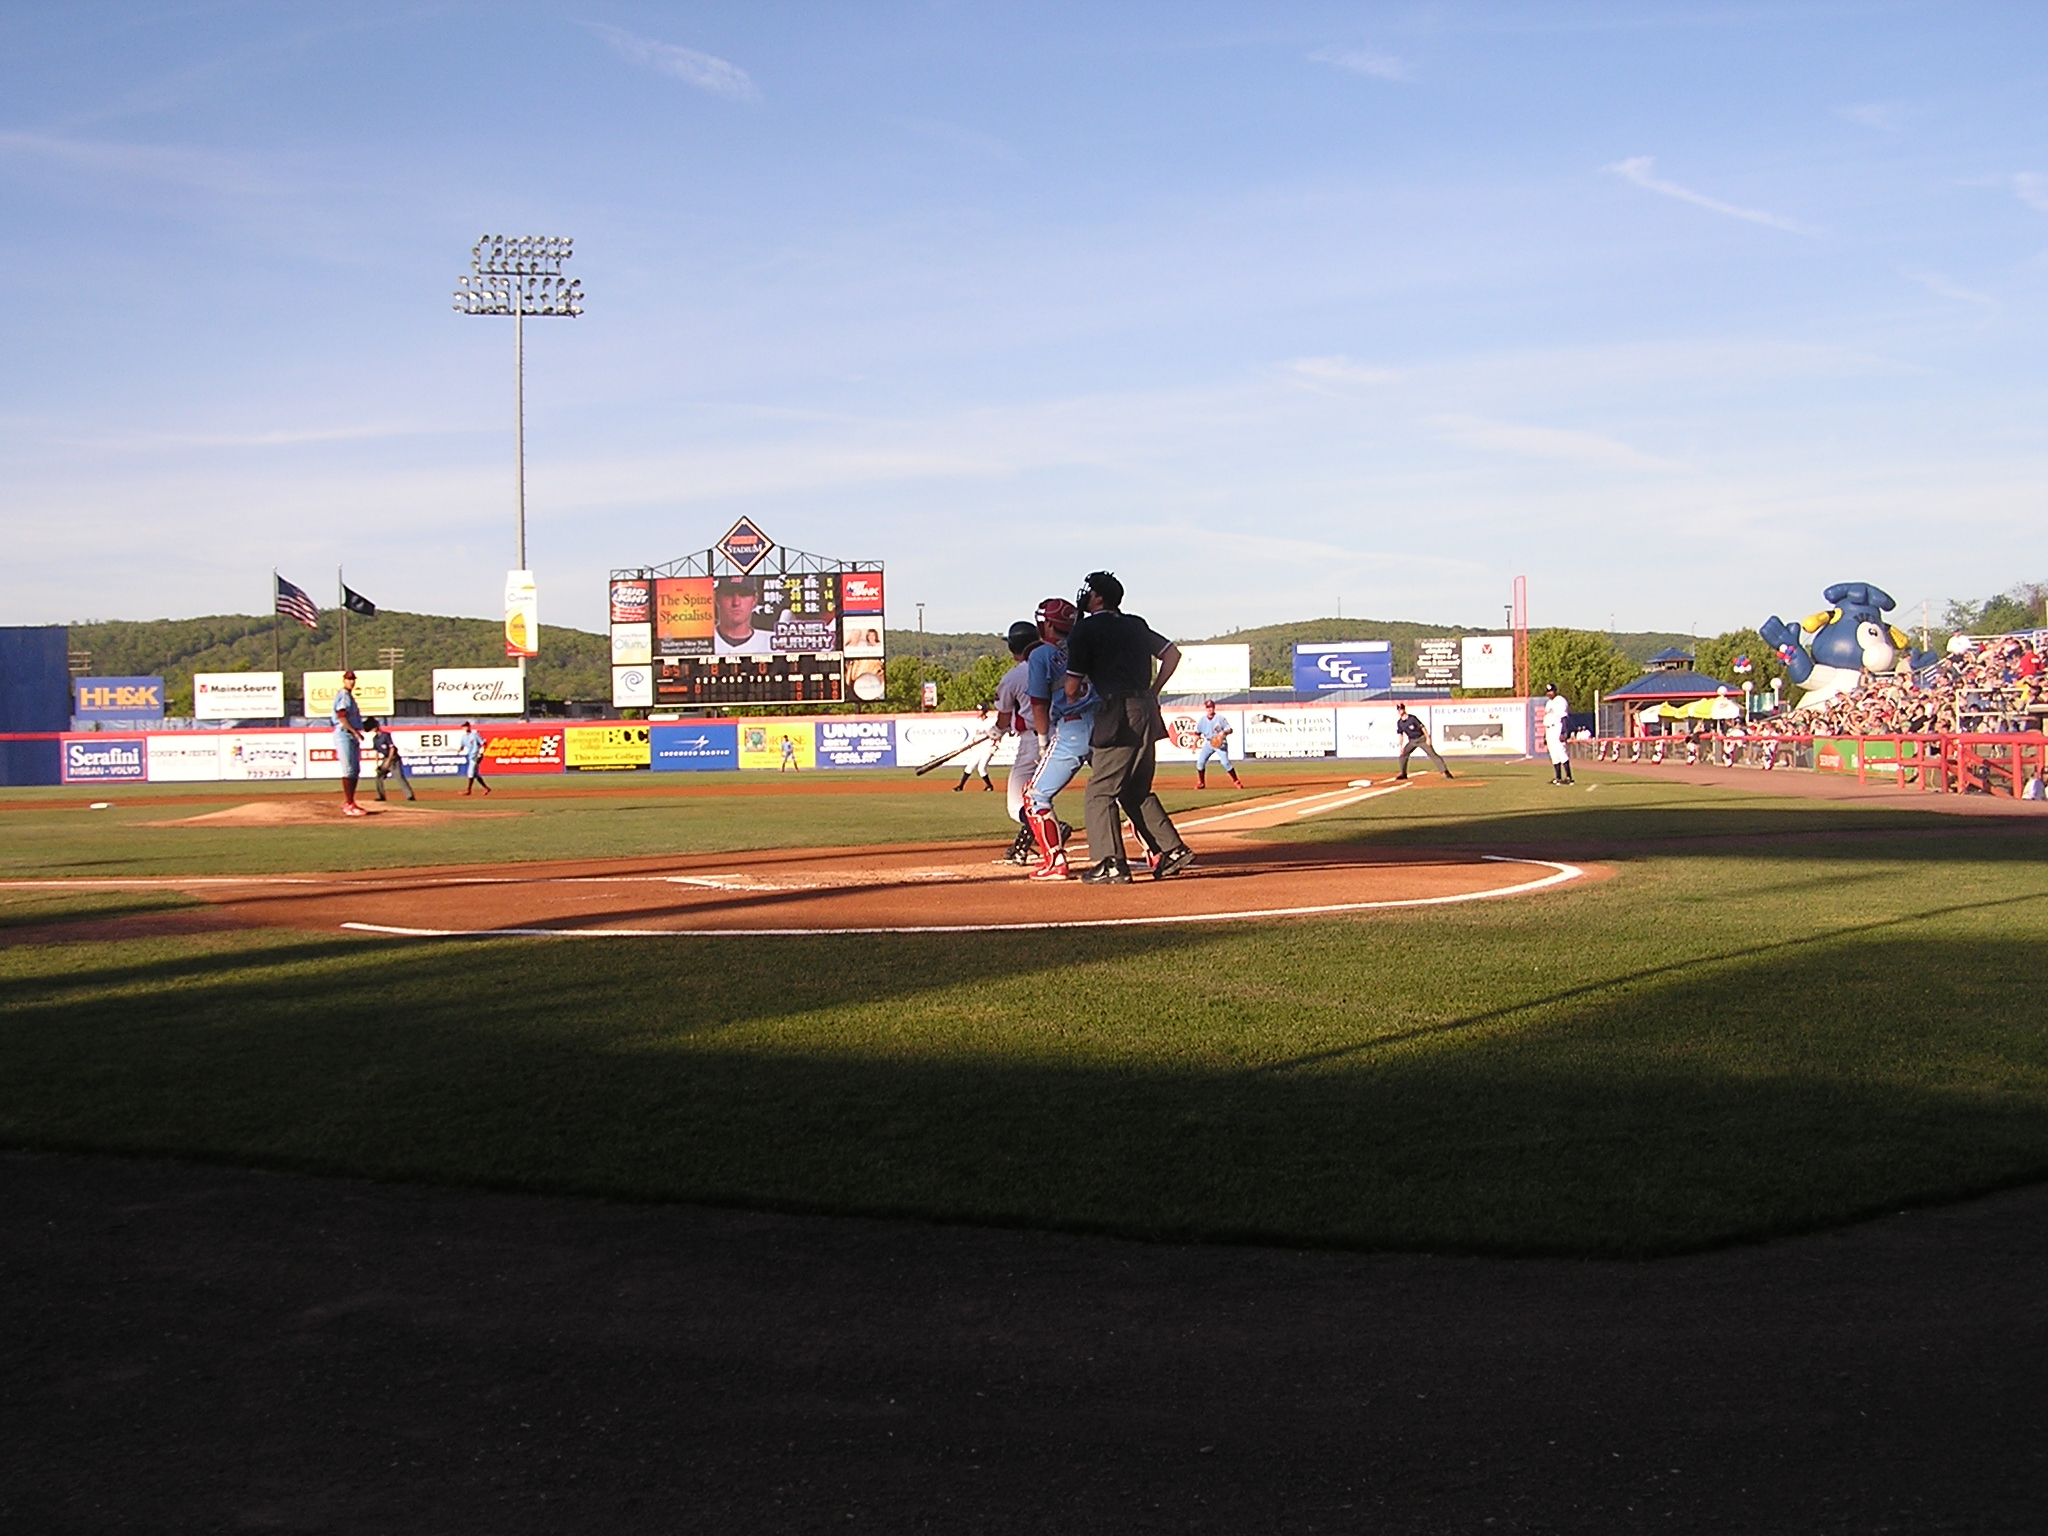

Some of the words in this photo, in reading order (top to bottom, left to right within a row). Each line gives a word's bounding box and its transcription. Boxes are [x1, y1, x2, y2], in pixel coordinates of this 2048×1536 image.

[727, 544, 762, 553] STADIUM
[764, 580, 783, 590] AVG:
[827, 578, 833, 587] 5
[618, 587, 647, 596] BUD
[614, 595, 648, 603] LIGHT
[660, 595, 679, 606] The
[683, 593, 712, 608] Spine
[660, 609, 712, 625] Specialists
[777, 624, 827, 635] DANIEL
[772, 636, 832, 648] MURPHY
[1317, 654, 1368, 684] CFG
[436, 681, 504, 692] Rockwell
[80, 686, 159, 706] HH&K
[473, 687, 519, 701] Collins
[823, 723, 888, 738] UNION
[421, 734, 448, 747] EBI
[489, 737, 538, 748] Advance
[70, 746, 139, 766] Serafini
[311, 750, 333, 760] BAE
[109, 766, 141, 775] VOLVO
